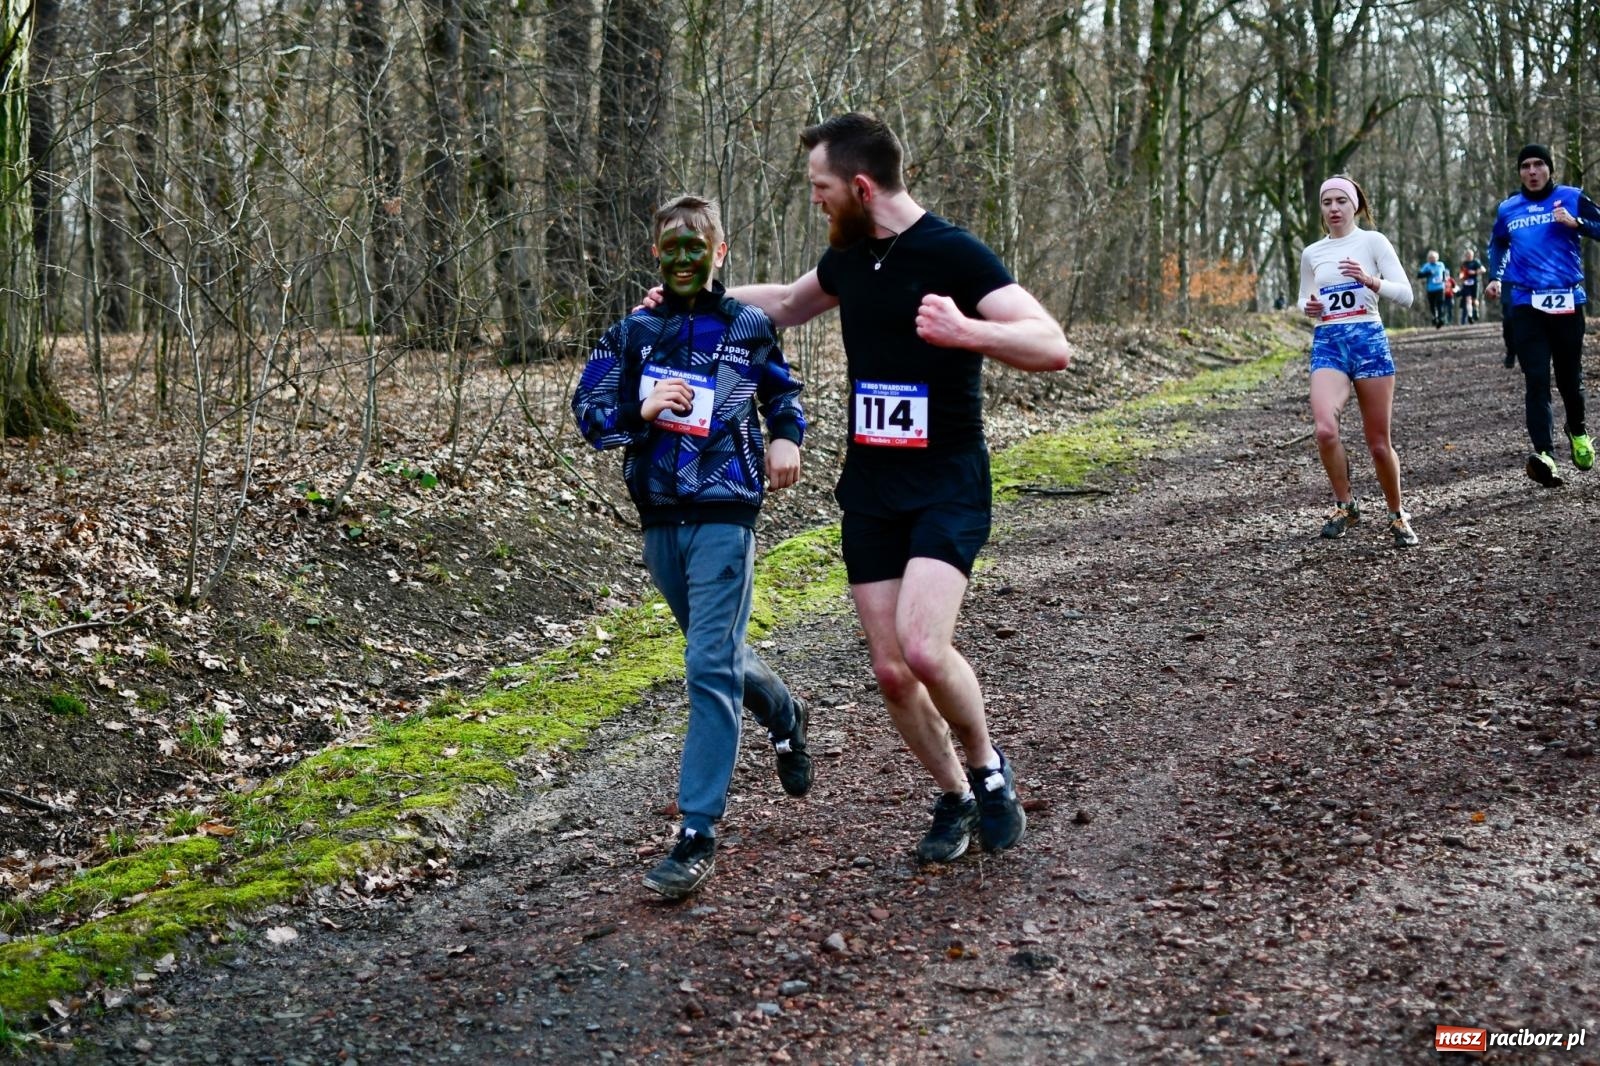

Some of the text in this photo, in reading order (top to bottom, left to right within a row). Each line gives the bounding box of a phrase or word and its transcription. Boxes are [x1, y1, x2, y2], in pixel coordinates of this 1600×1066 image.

[1328, 290, 1356, 312] 20
[1541, 294, 1566, 309] 42
[879, 384, 918, 392] TWARDZIELA
[863, 396, 914, 431] 114
